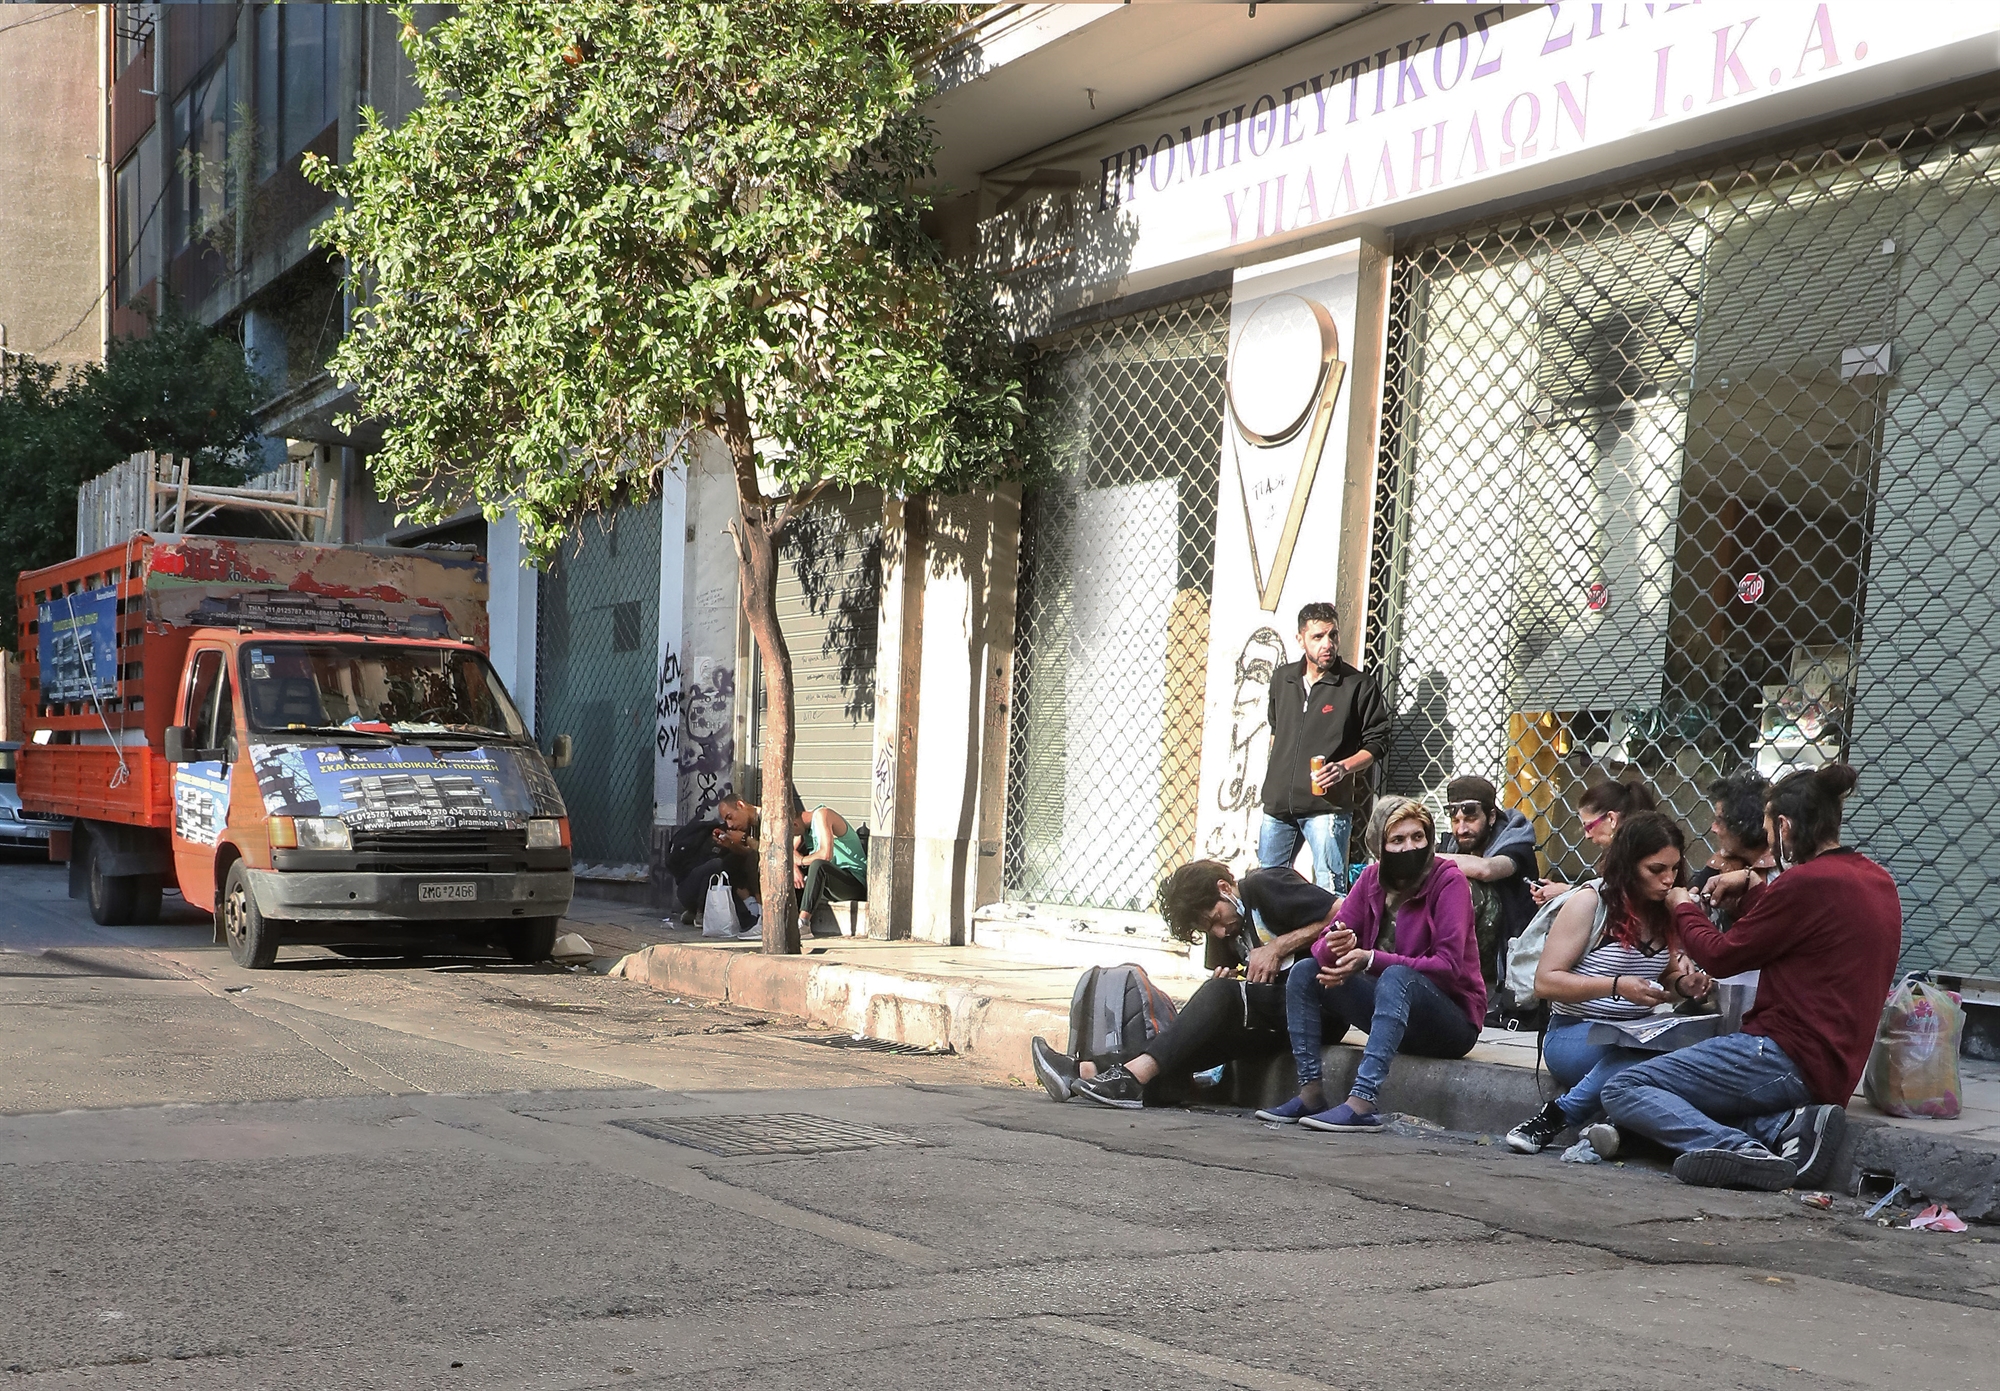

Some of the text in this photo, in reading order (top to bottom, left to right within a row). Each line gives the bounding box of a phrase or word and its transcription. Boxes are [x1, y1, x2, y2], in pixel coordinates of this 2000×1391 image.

[1097, 5, 1503, 214] ΠΡΟΜΗΘΕΥΤΙΚΟΣ
[1223, 71, 1595, 247] ΥΠΑΛΛΗΛΩΝ
[1741, 580, 1762, 596] STOP
